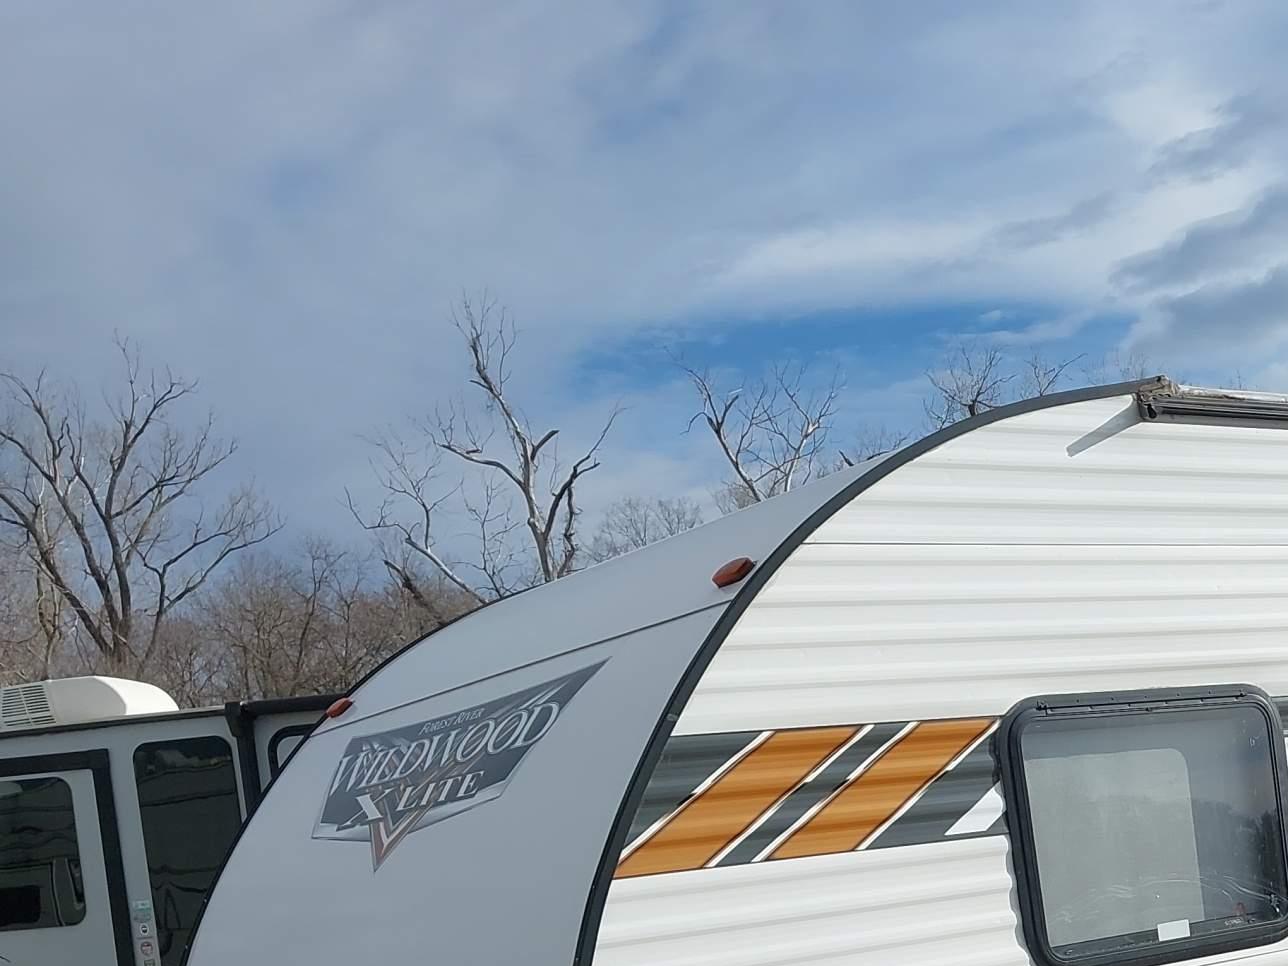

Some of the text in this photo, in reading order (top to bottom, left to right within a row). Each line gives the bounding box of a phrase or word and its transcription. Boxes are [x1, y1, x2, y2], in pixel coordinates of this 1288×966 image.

[329, 701, 560, 797] WILDWOOD
[419, 707, 486, 736] FOREST RIVER
[336, 770, 486, 832] X LITE
